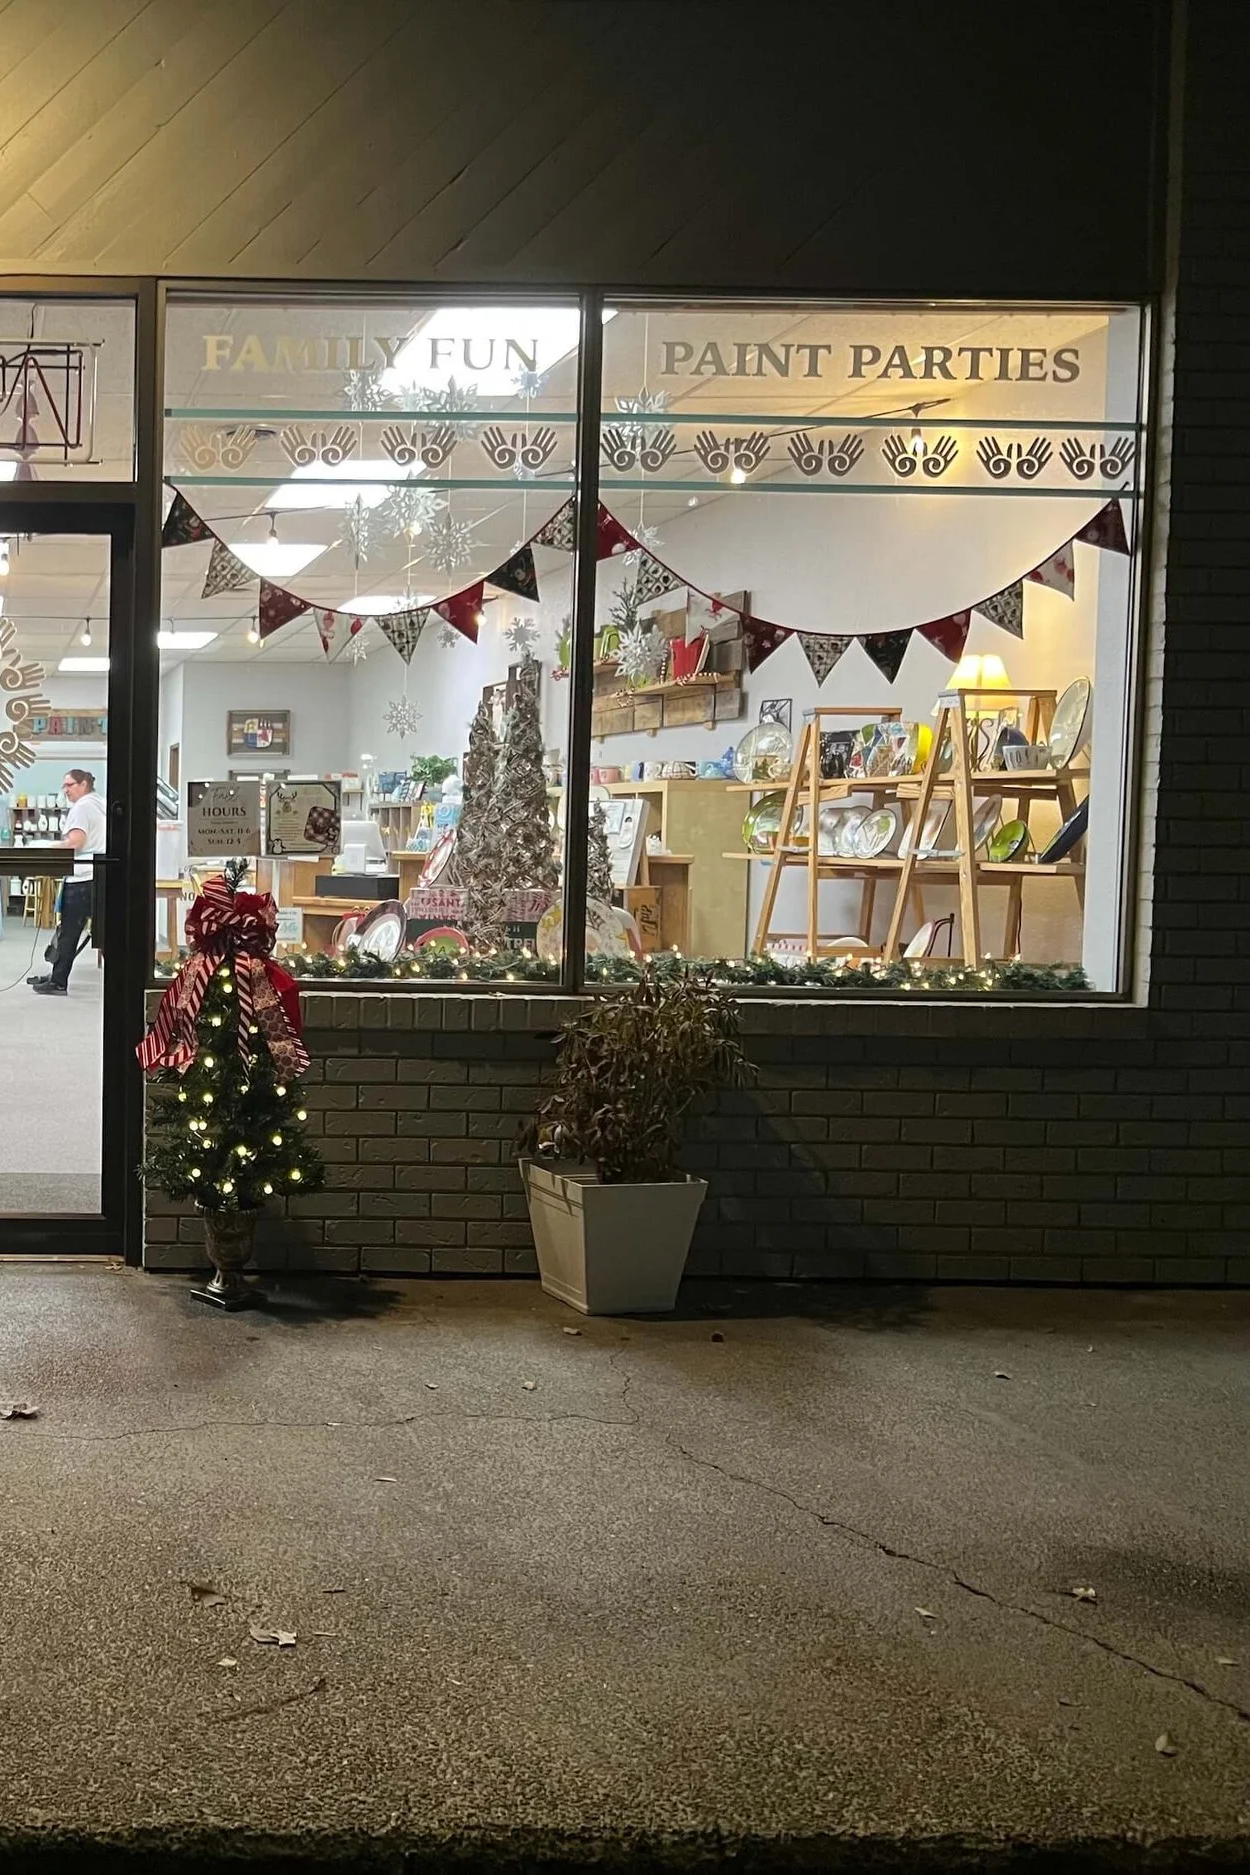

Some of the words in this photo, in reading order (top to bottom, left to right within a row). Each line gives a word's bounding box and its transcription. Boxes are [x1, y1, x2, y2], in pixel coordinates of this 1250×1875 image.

[202, 335, 409, 372] FAMILY
[429, 337, 538, 372] FUN
[661, 341, 831, 377] PAINT
[848, 344, 1081, 383] PARTIES
[32, 717, 107, 735] PAINT
[202, 807, 246, 817] HOURS
